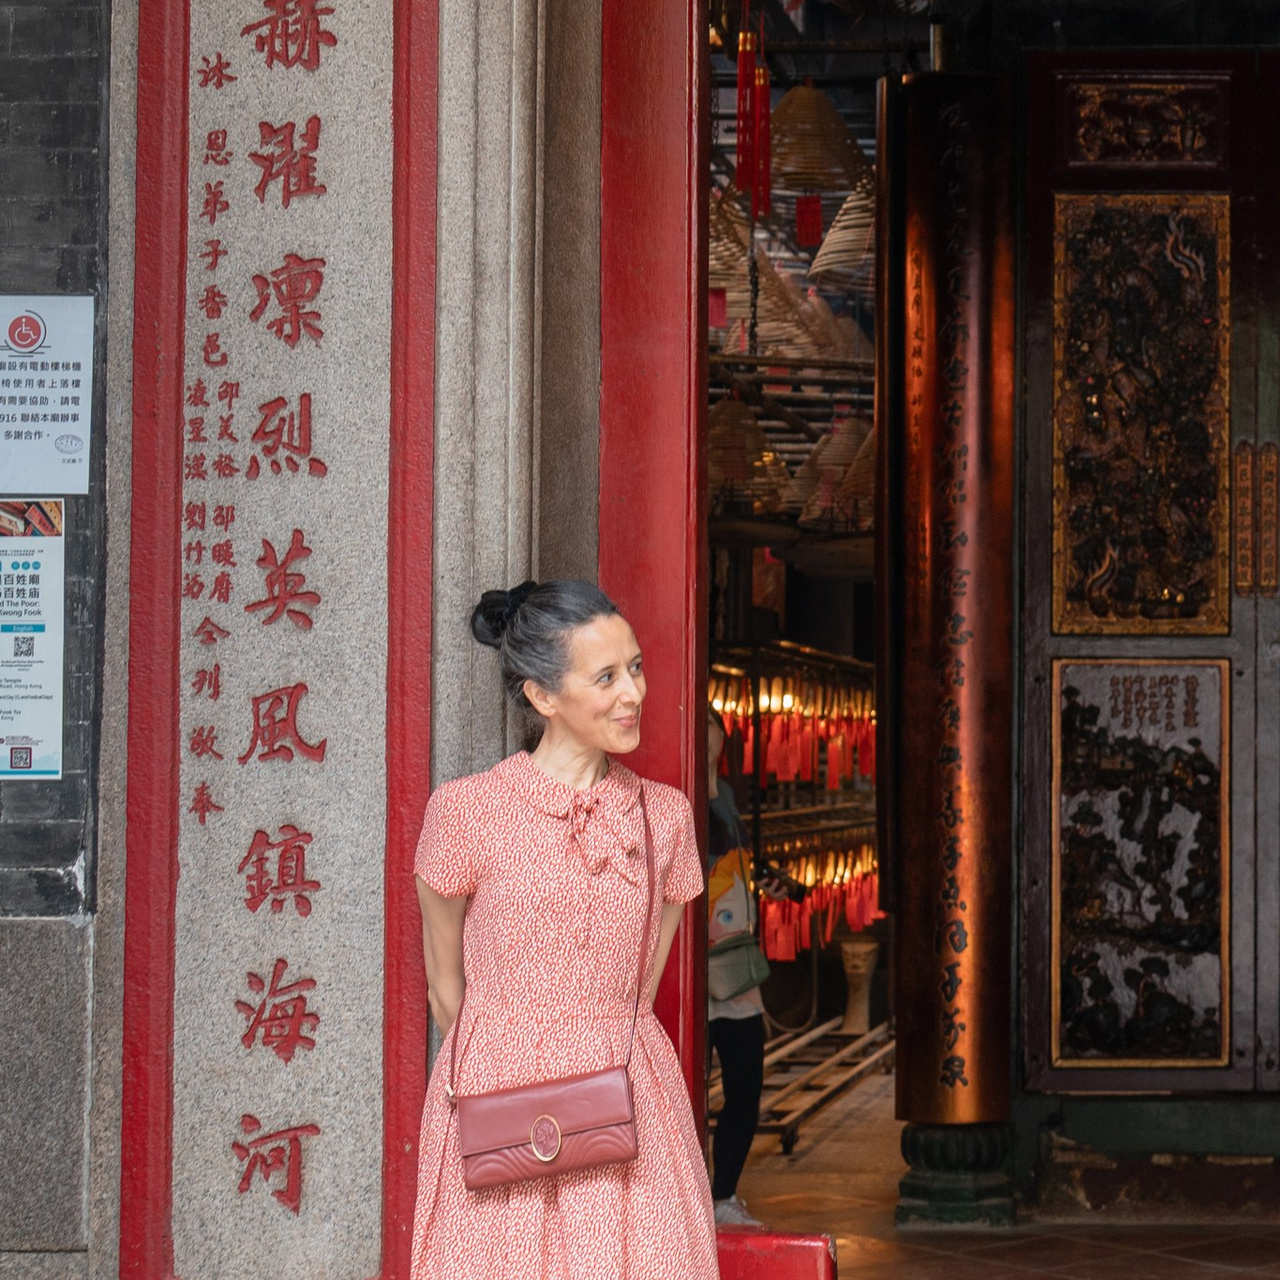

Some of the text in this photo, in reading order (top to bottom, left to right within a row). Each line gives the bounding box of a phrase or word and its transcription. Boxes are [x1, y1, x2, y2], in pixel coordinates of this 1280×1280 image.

[0, 574, 40, 585] 百姓廟
[0, 587, 40, 599] 百姓庙
